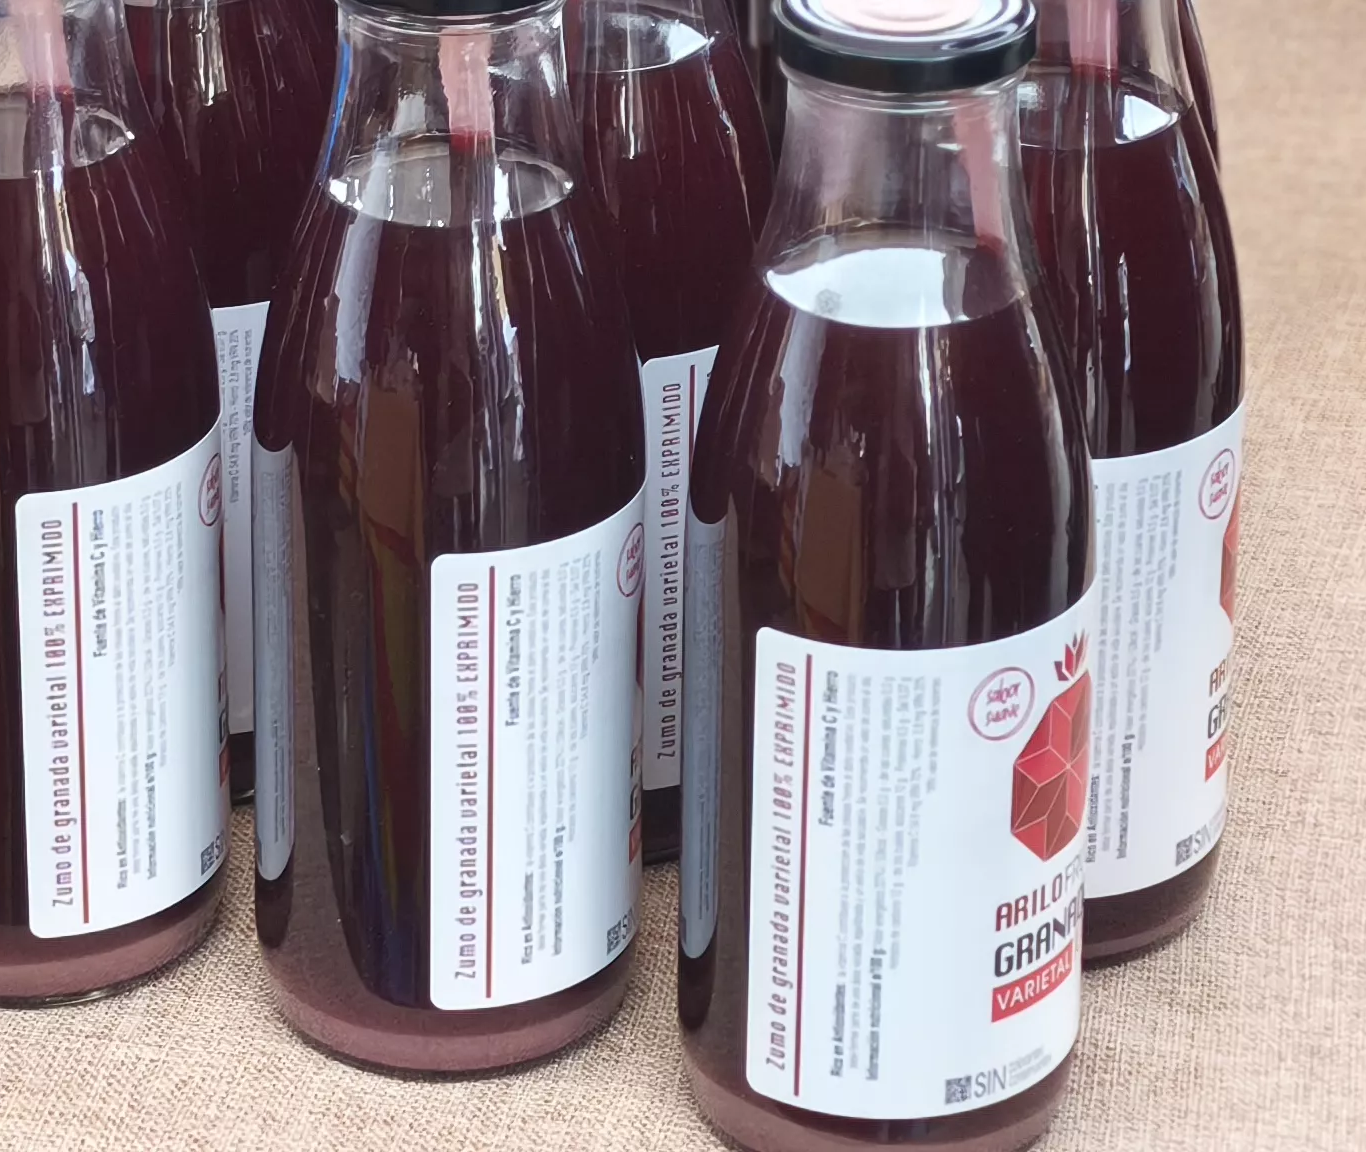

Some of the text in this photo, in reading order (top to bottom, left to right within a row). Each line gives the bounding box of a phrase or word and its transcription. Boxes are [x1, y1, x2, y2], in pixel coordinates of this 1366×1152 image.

[40, 519, 77, 907] Zumo de granada varietal 100% EXPRIMIDO
[657, 382, 682, 759] Zumo de granada varietal 100% EXPRIMIDO
[454, 582, 484, 979] Zumo de granada varietal 100% EXPRIMIDO
[765, 661, 796, 1071] Zumo de granada varietal 100% EXPRIMIDO
[974, 1065, 1007, 1098] SIN
[996, 951, 1070, 1011] VARIETAL
